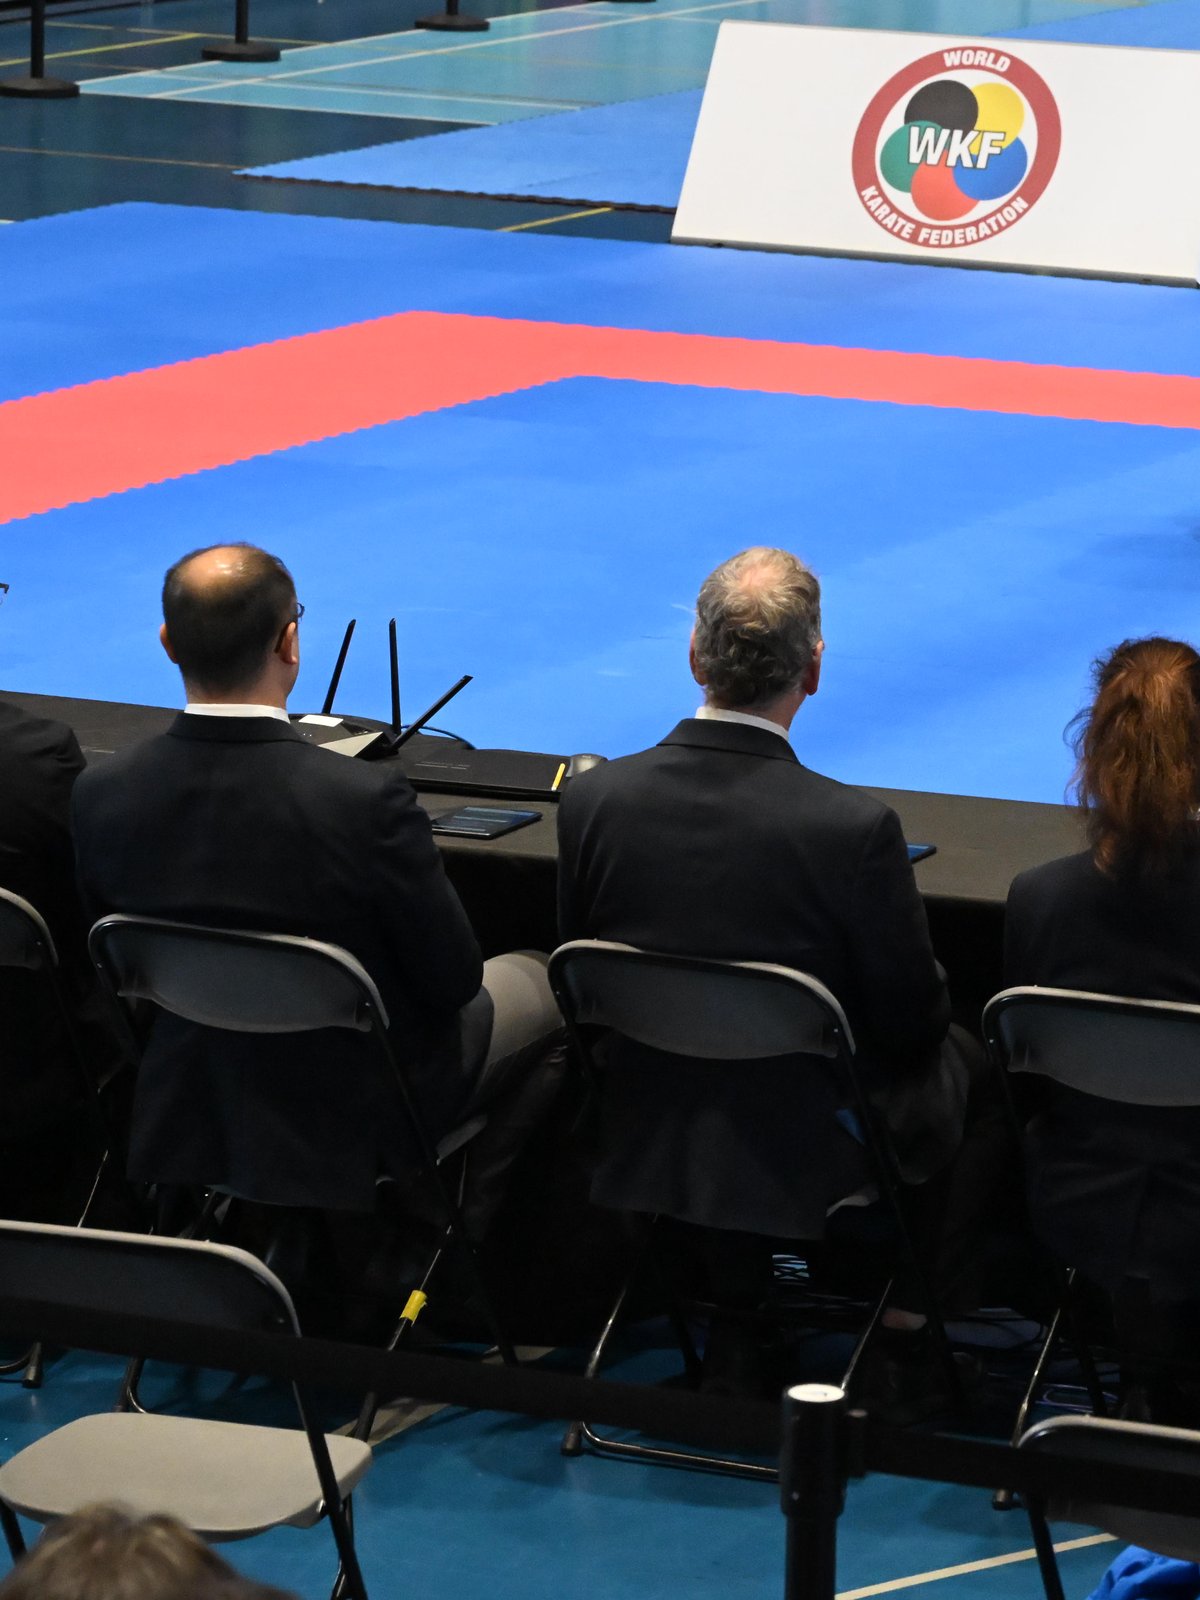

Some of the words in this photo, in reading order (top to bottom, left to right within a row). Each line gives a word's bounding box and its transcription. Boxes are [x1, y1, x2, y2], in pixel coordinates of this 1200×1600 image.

[943, 49, 1011, 72] WORLD
[908, 125, 1007, 170] WKF
[861, 185, 916, 239] KARATE
[917, 196, 1029, 246] FEDERATION
